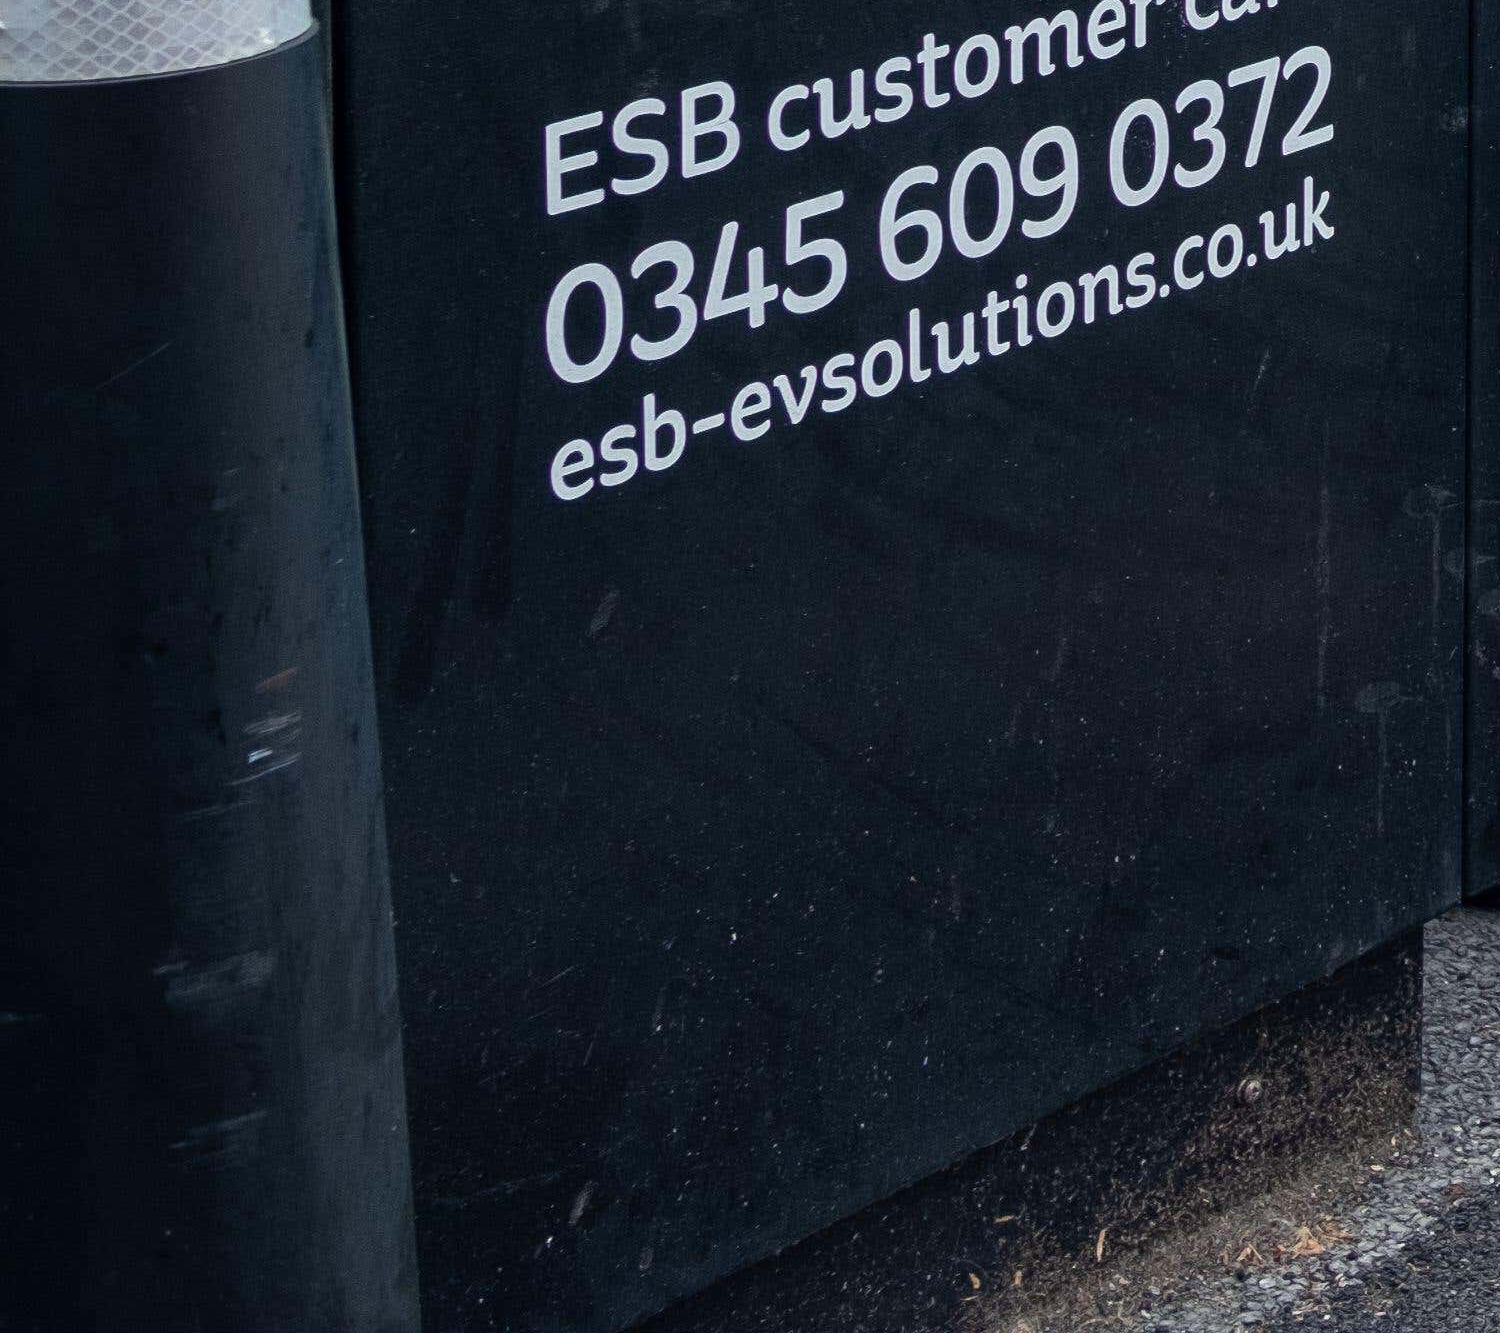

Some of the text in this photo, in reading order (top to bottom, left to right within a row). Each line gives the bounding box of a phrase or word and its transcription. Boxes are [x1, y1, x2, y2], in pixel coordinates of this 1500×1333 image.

[543, 80, 741, 217] ESB
[543, 45, 1335, 385] 0345 609 0372
[549, 176, 1335, 502] esb-evsolutions.co.uk
